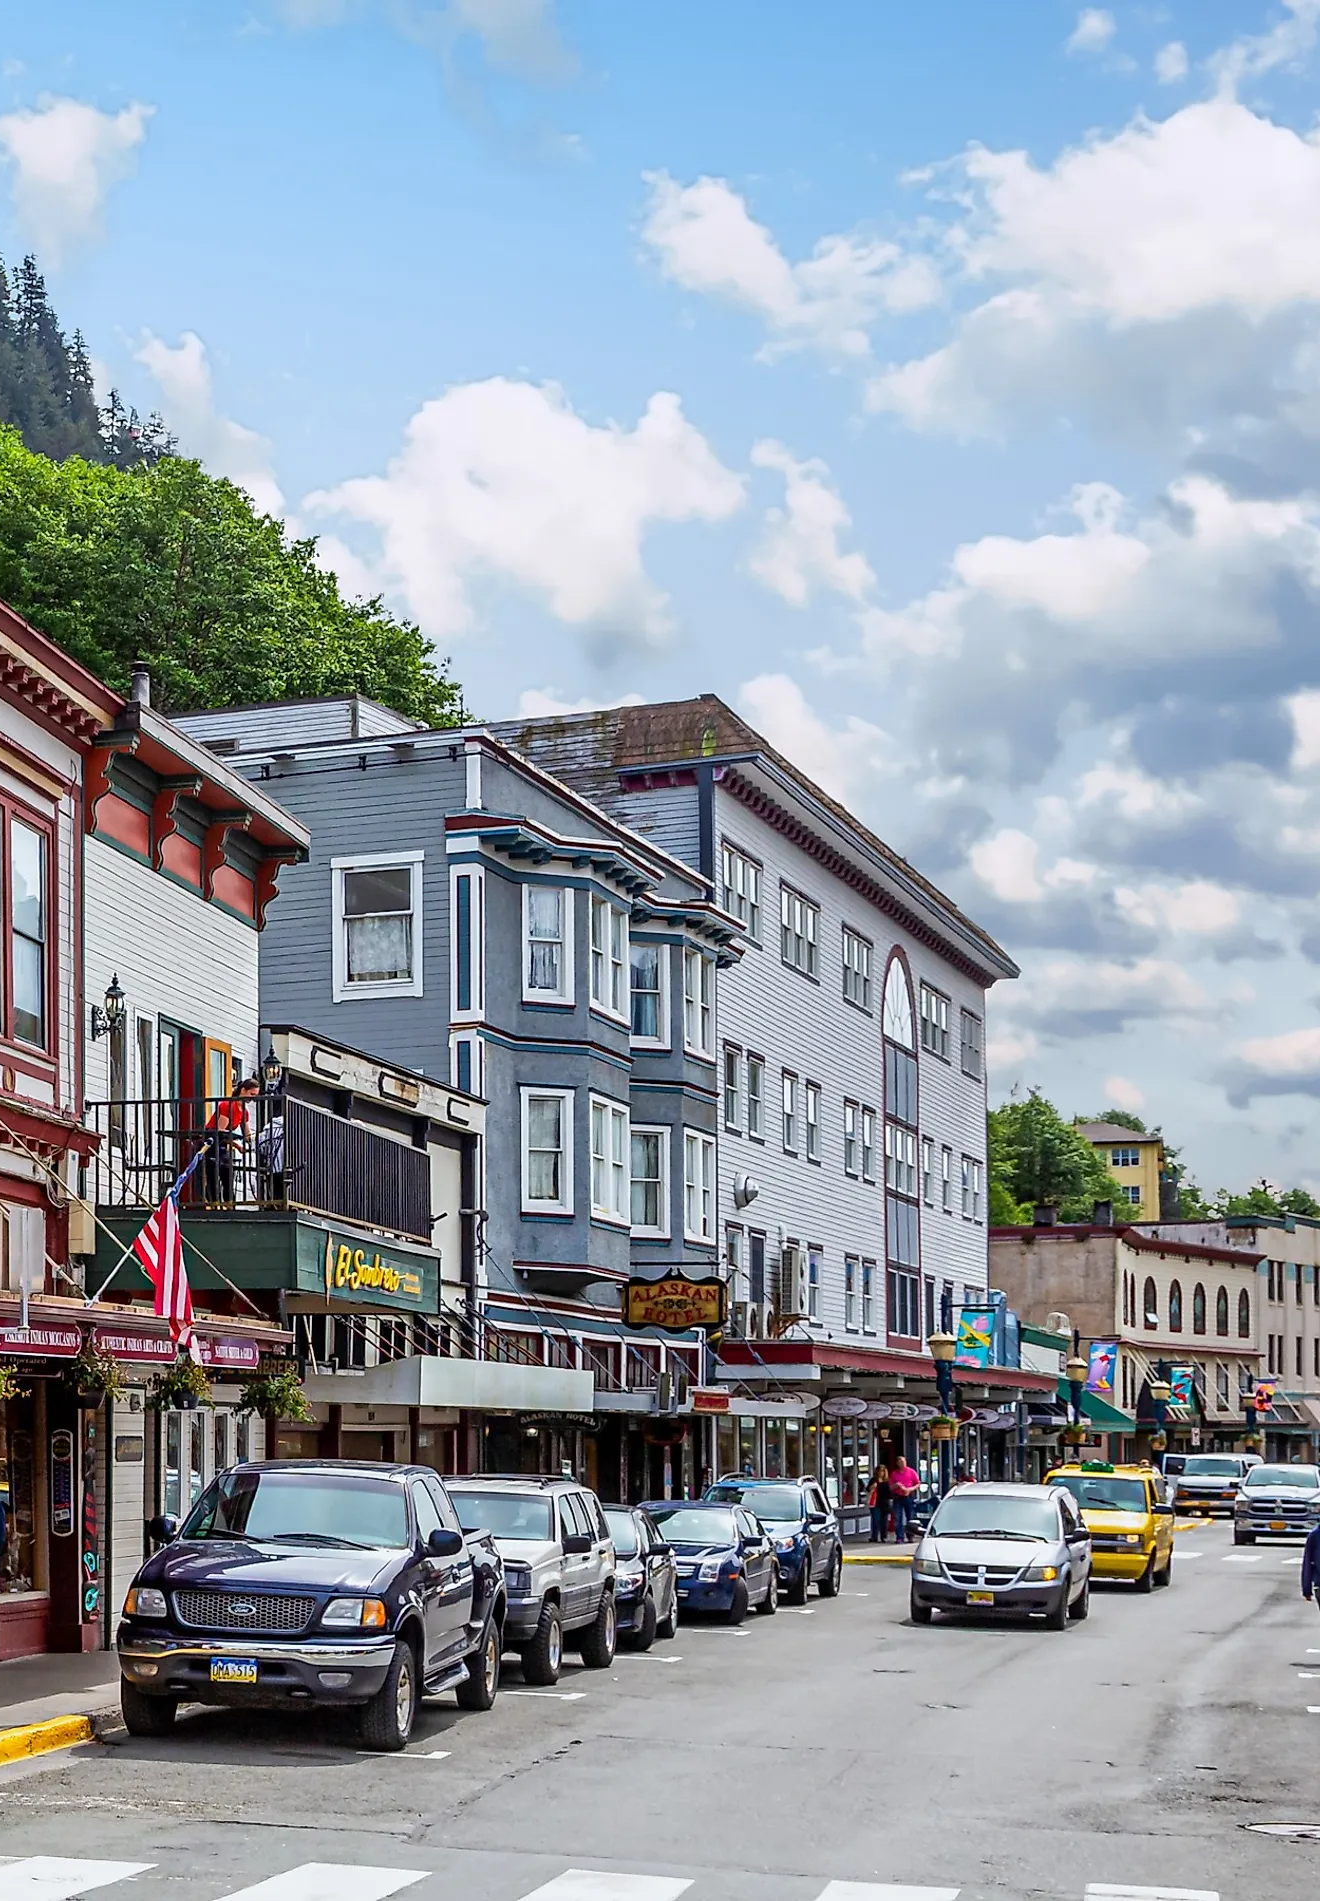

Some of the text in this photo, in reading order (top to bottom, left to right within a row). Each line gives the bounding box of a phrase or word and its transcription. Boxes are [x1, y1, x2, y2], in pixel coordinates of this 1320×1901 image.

[350, 1249, 400, 1292] Sombrero
[632, 1282, 717, 1303] ALASKAN
[642, 1307, 708, 1324] HOTEL
[9, 1356, 47, 1365] Operated
[520, 1412, 596, 1426] ALASKAN HOTEL
